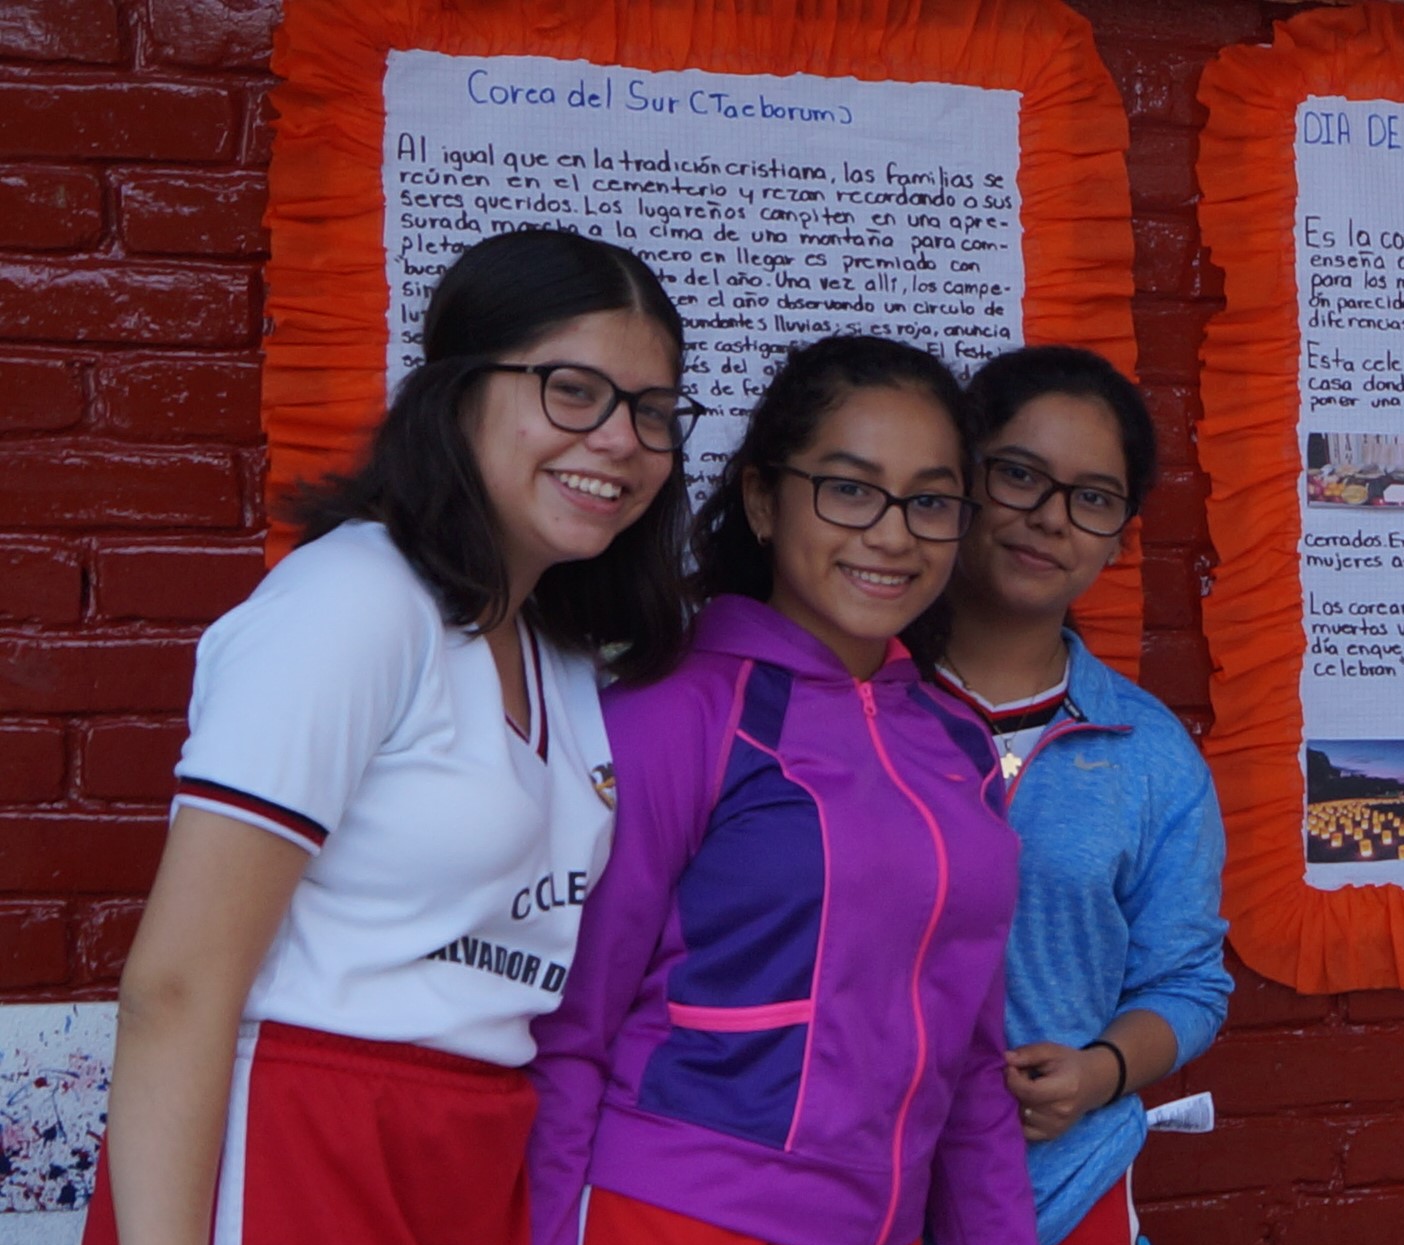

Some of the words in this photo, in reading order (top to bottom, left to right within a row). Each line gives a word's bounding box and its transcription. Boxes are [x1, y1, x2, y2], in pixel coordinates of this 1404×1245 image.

[567, 77, 612, 108] del
[625, 80, 679, 114] Sur
[1304, 111, 1350, 145] DIA
[1368, 114, 1402, 149] DE
[397, 133, 426, 162] Al
[441, 143, 495, 171] igual
[503, 152, 549, 173] que
[557, 153, 586, 168] en
[594, 148, 614, 170] la
[617, 148, 720, 175] tradición
[725, 158, 836, 184] cristiana,
[886, 161, 974, 188] familias
[983, 173, 1004, 189] se
[506, 176, 540, 190] en
[553, 173, 579, 192] el
[739, 187, 754, 205] y
[981, 195, 1012, 210] sus
[400, 189, 464, 208] seres
[474, 195, 580, 215] queridos.
[584, 197, 623, 215] Los
[638, 197, 746, 223] lugareños
[871, 211, 896, 226] en
[907, 214, 941, 229] una
[949, 214, 1009, 236] apre-
[400, 210, 481, 233] surada
[589, 223, 602, 236] a
[616, 221, 637, 239] la
[649, 224, 703, 240] cima
[713, 223, 741, 242] de
[752, 230, 787, 244] una
[911, 235, 955, 253] para
[1305, 216, 1336, 248] Es
[1349, 218, 1371, 247] la
[1310, 251, 1385, 269] enseña
[1307, 340, 1355, 373] Esta
[1307, 553, 1383, 571] mujeres
[1309, 592, 1343, 615] Los
[1311, 618, 1388, 636] muertos
[1311, 636, 1339, 655] día
[1313, 659, 1396, 677] celebran
